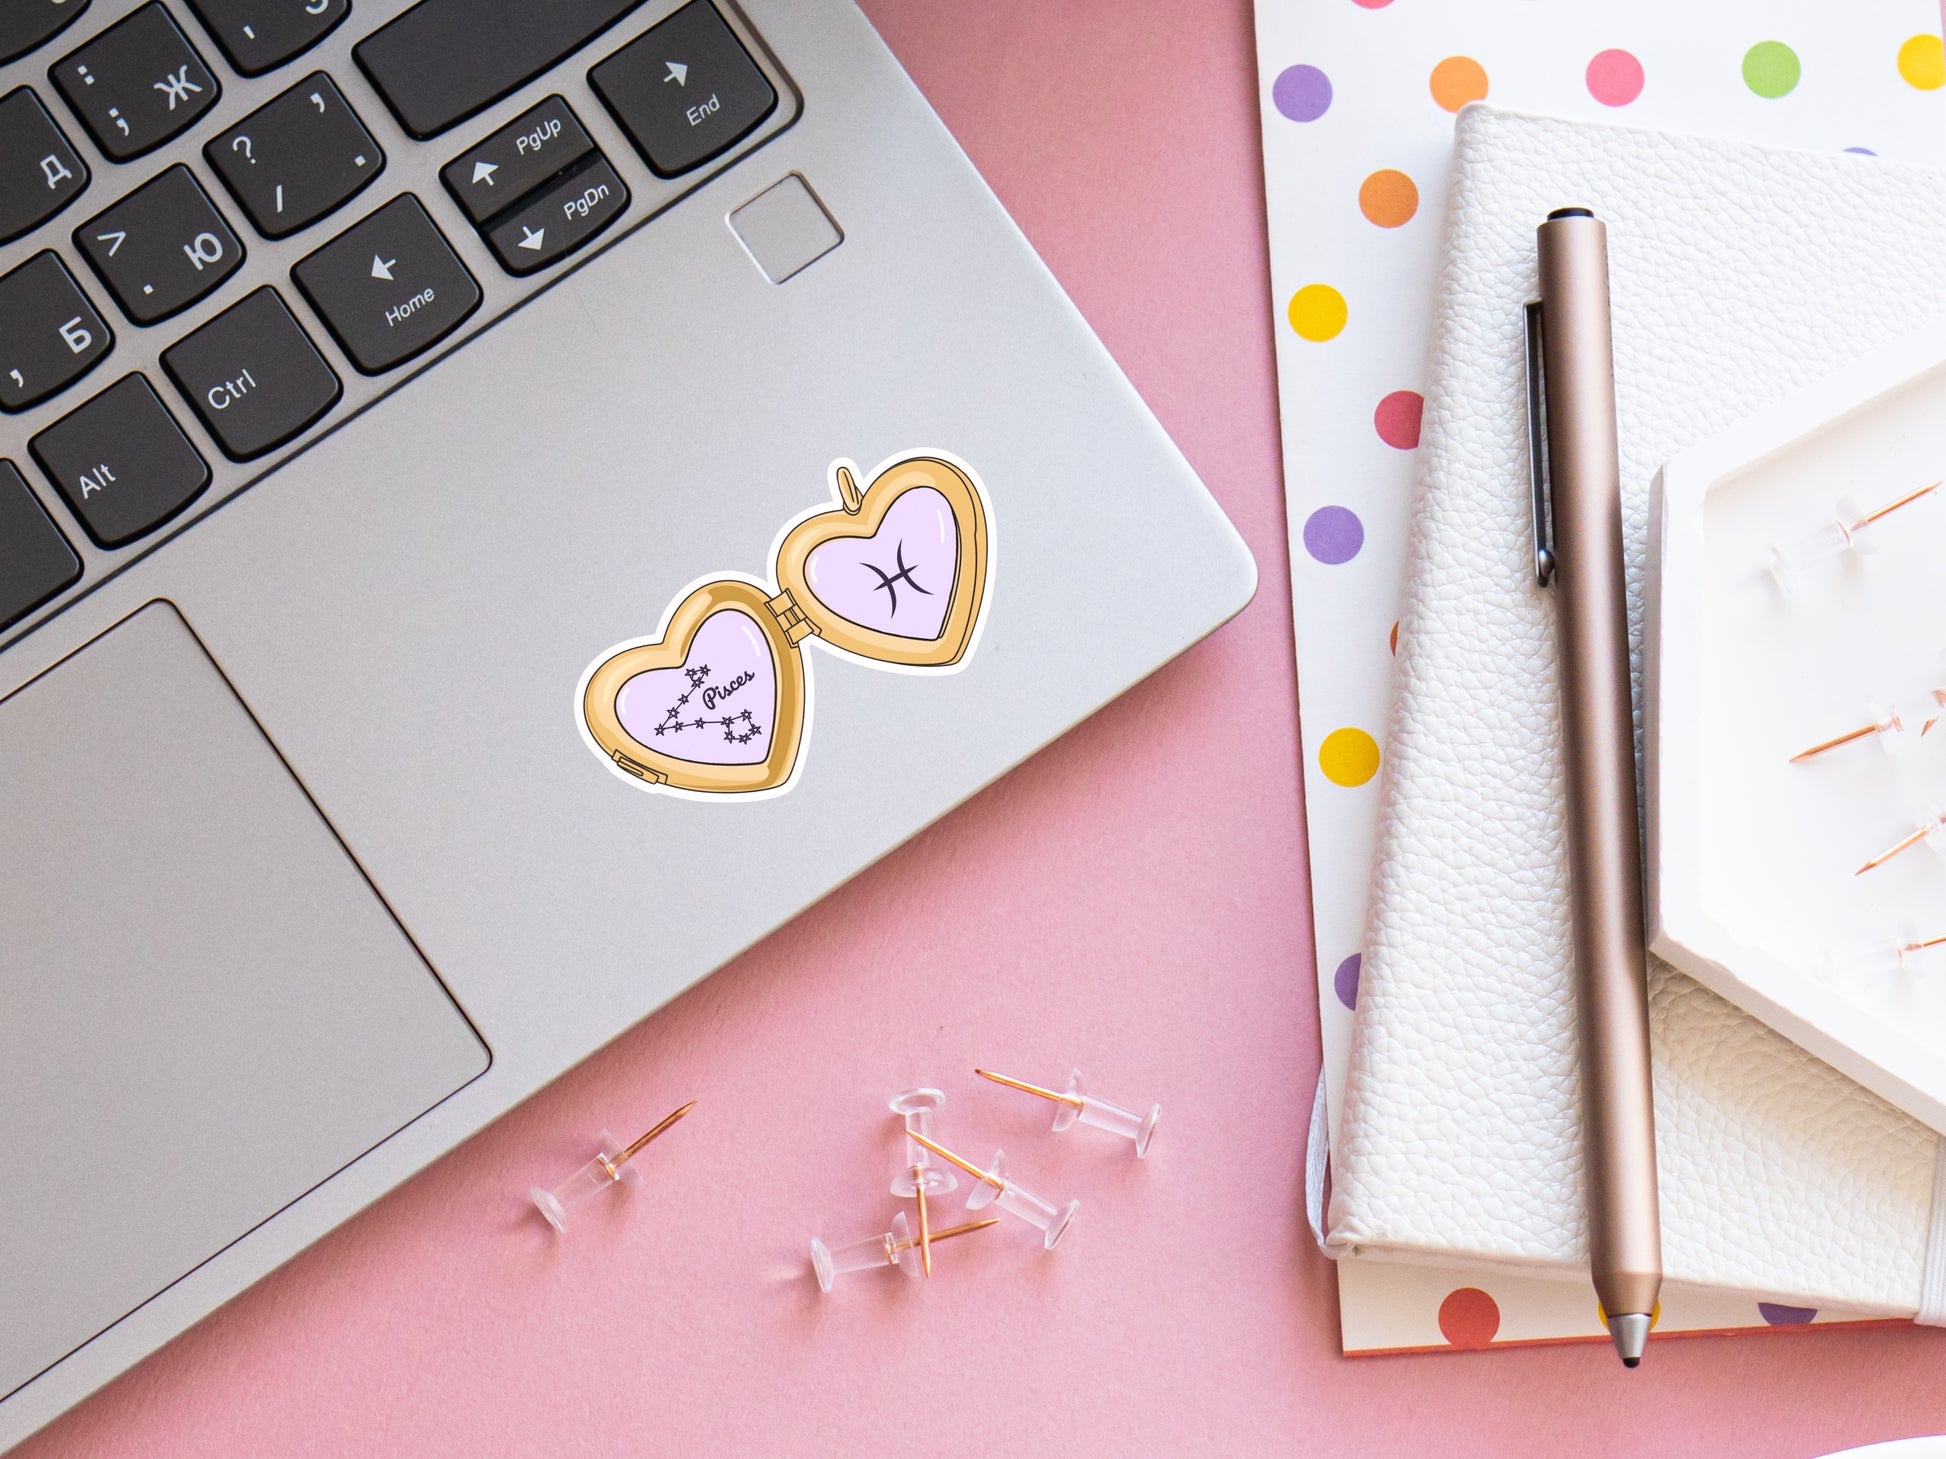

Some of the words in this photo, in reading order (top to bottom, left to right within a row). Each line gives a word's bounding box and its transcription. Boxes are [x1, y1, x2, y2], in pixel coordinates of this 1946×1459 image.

[153, 64, 203, 111] Ж
[108, 107, 130, 137] ;
[686, 93, 721, 127] End
[232, 135, 257, 165] ?
[515, 117, 562, 155] PgUp
[39, 154, 73, 190] Д
[276, 184, 283, 213] /
[563, 183, 610, 221] PgDn
[183, 232, 224, 271] Ю
[385, 287, 436, 327] Home
[58, 316, 93, 354] Б
[207, 368, 257, 410] Ctrl
[79, 463, 117, 500] Alt
[702, 670, 755, 710] Pisces
